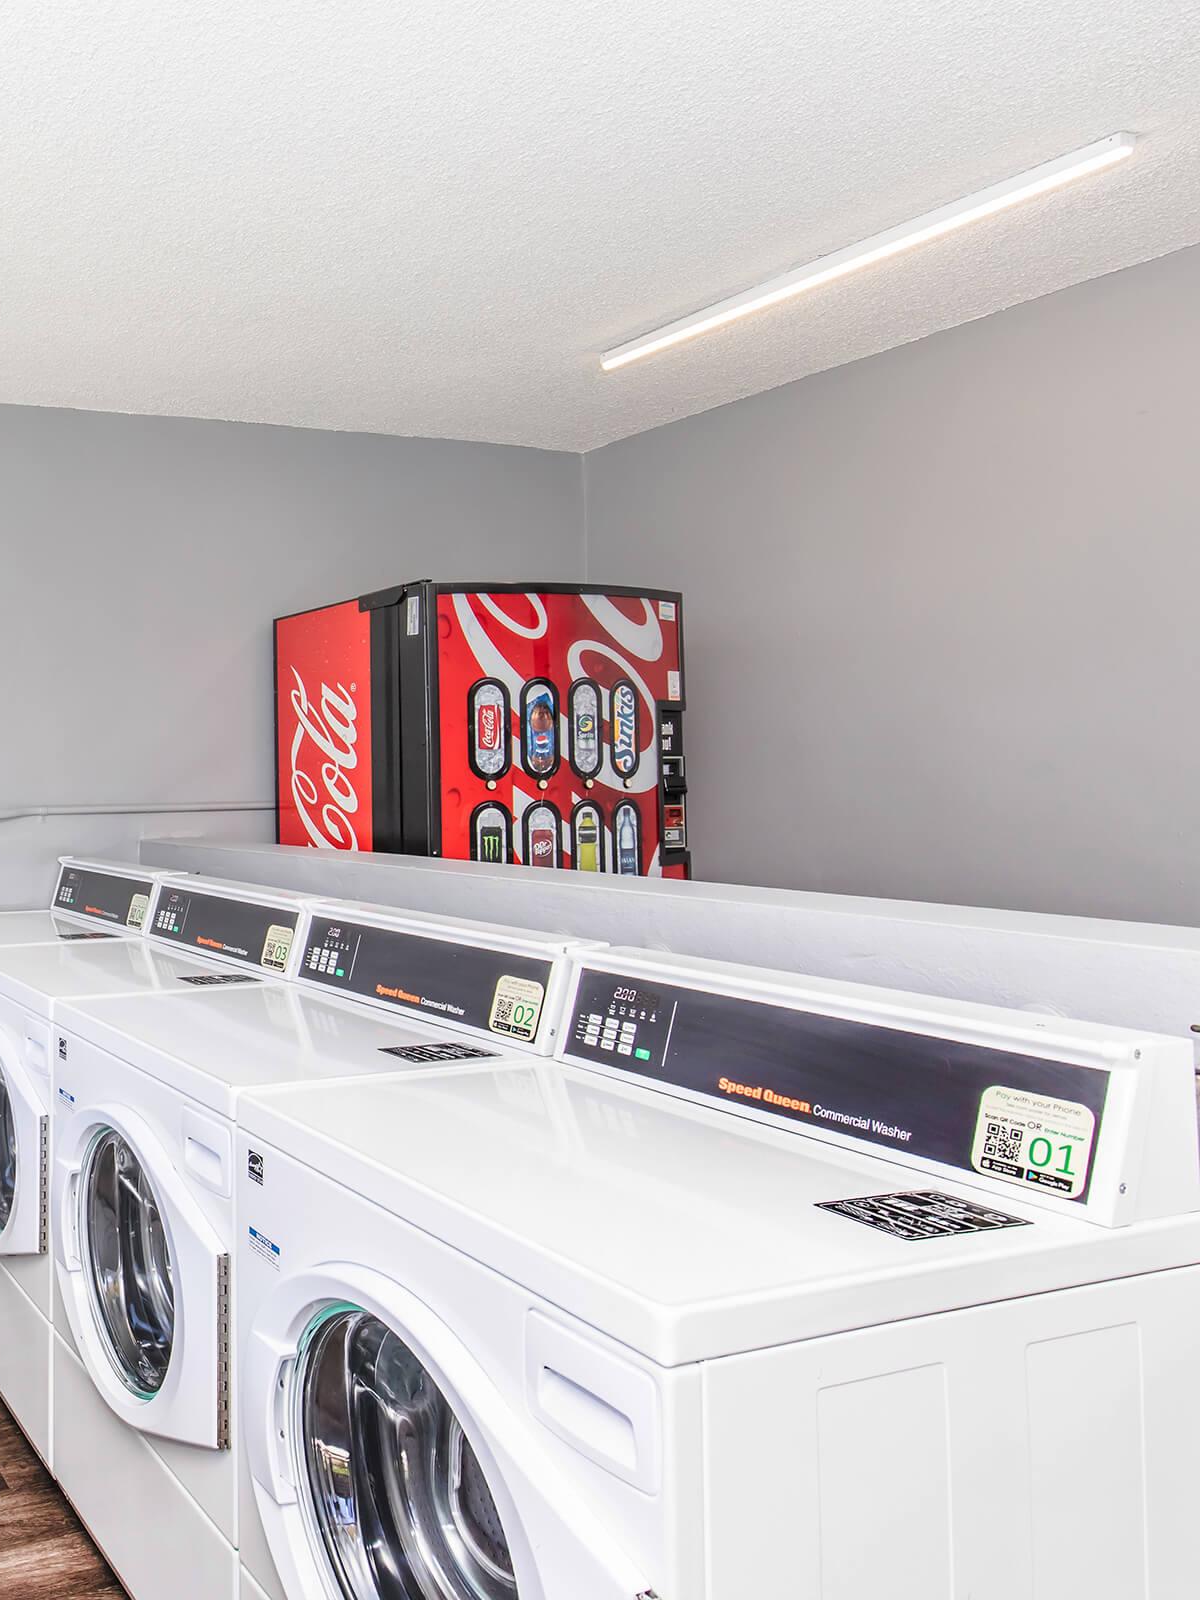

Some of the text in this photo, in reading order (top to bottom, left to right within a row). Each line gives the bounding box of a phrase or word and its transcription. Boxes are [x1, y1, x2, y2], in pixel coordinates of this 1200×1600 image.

[275, 945, 287, 961] 03
[513, 1005, 535, 1027] 02
[718, 1077, 912, 1141] Speed Queen Commercial Washer
[995, 1090, 1011, 1100] Pay
[1013, 1095, 1030, 1104] with
[1031, 1100, 1051, 1109] your
[1053, 1103, 1081, 1116] Phone
[985, 1113, 999, 1121] Scan
[1009, 1118, 1026, 1127] Code
[1027, 1121, 1042, 1131] OR
[1028, 1137, 1075, 1176] 01
